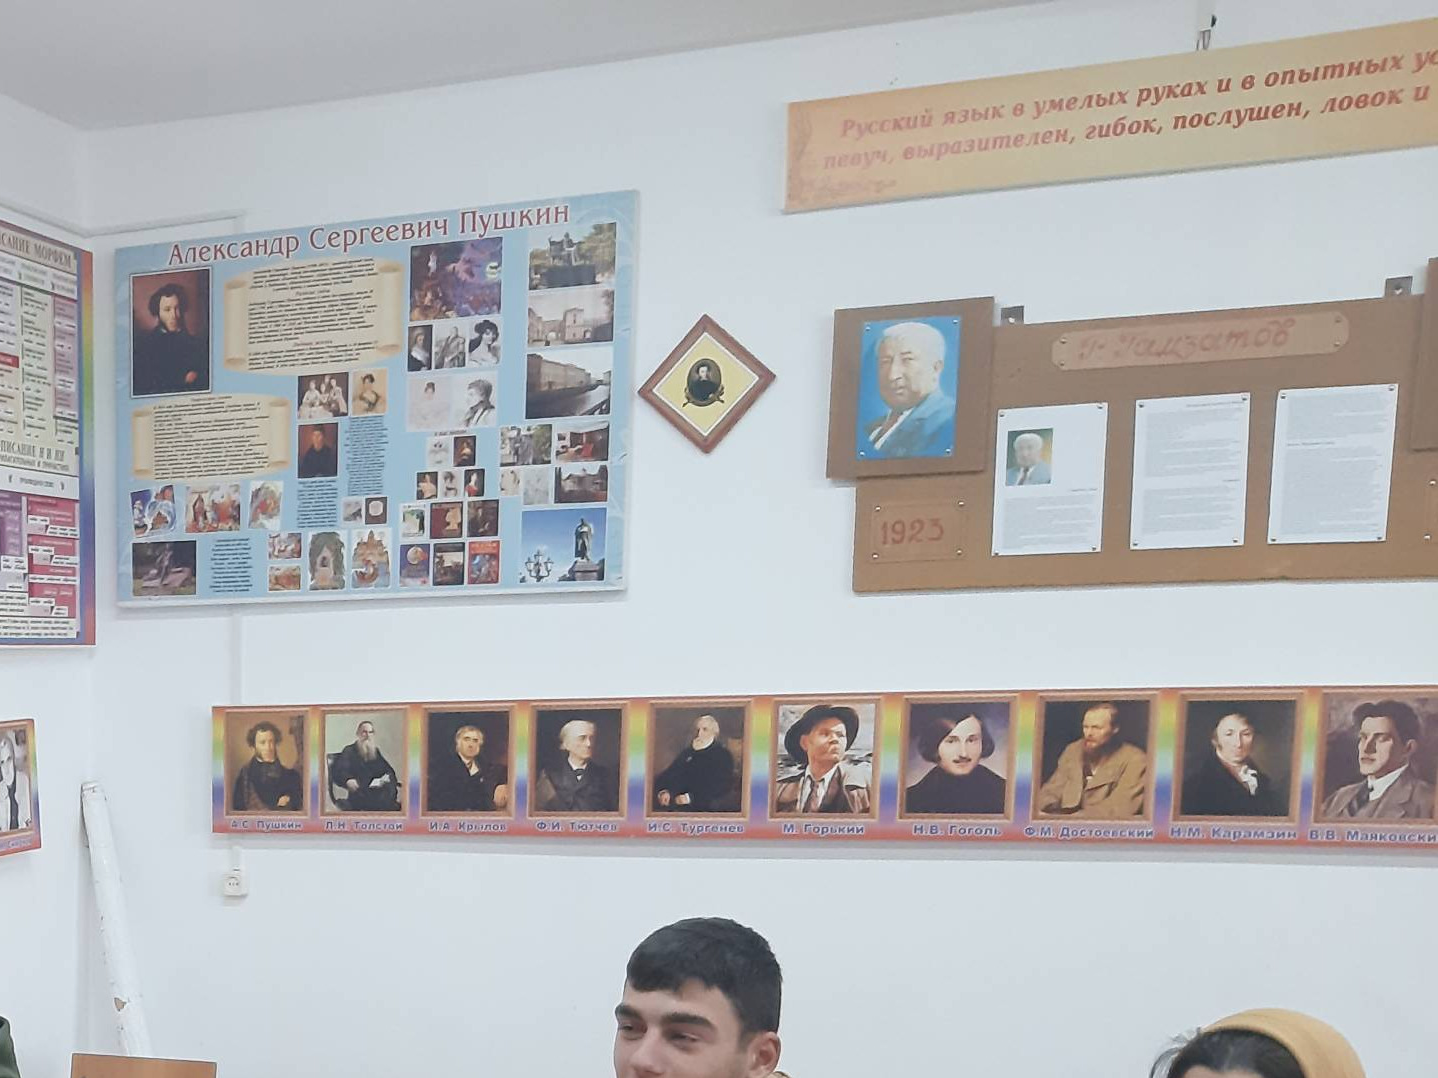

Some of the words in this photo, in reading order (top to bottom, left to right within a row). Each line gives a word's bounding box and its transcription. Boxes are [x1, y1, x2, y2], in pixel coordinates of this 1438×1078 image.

[840, 108, 933, 141] Русский
[942, 104, 1005, 125] язык
[1012, 101, 1025, 117] в
[1032, 89, 1128, 120] умелых
[1136, 79, 1208, 107] руках
[1216, 77, 1231, 93] и
[1241, 74, 1255, 91] в
[1264, 53, 1405, 88] опытных
[823, 148, 895, 171] певуч,
[902, 126, 1075, 161] выразителен,
[1085, 117, 1164, 140] гибок,
[1172, 101, 1311, 129] послушен,
[1320, 89, 1404, 113] ловок
[1413, 85, 1431, 101] и
[168, 231, 300, 266] Александр
[309, 218, 449, 258] Сергеевич
[460, 204, 570, 240] Пушкин
[33, 241, 71, 267] МОРФЕМ
[881, 518, 944, 545] 1923
[256, 820, 302, 832] Пушкин
[458, 821, 507, 833] Крылов
[570, 821, 617, 832] Тютчев
[681, 822, 744, 834] Тургенев
[783, 823, 798, 833] М.
[804, 822, 864, 835] Горький
[949, 825, 1001, 835] Гоголь
[1061, 826, 1154, 838] Достоевский
[1212, 827, 1297, 841] Карамзин
